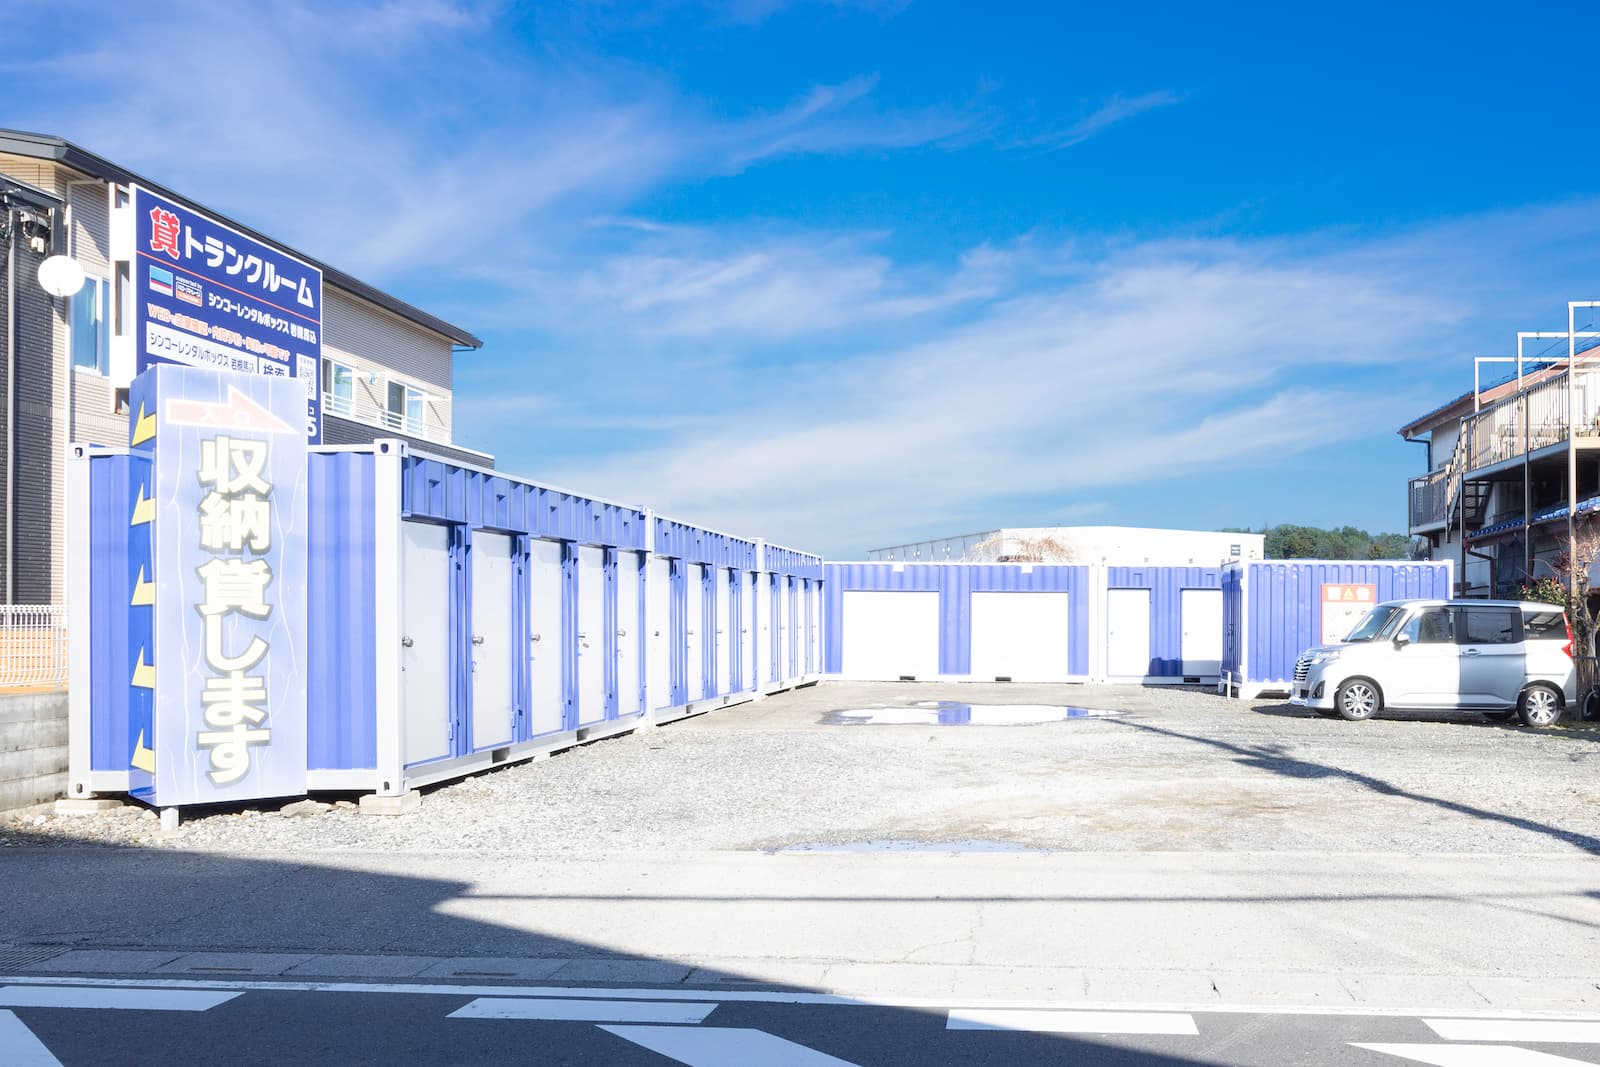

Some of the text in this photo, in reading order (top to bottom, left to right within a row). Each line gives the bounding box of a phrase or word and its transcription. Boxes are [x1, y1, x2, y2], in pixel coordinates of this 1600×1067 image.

[208, 292, 290, 337] シンコーレンタルボックス
[150, 332, 230, 368] シンコーレンタルボックス
[197, 434, 273, 788] 収納貸します
